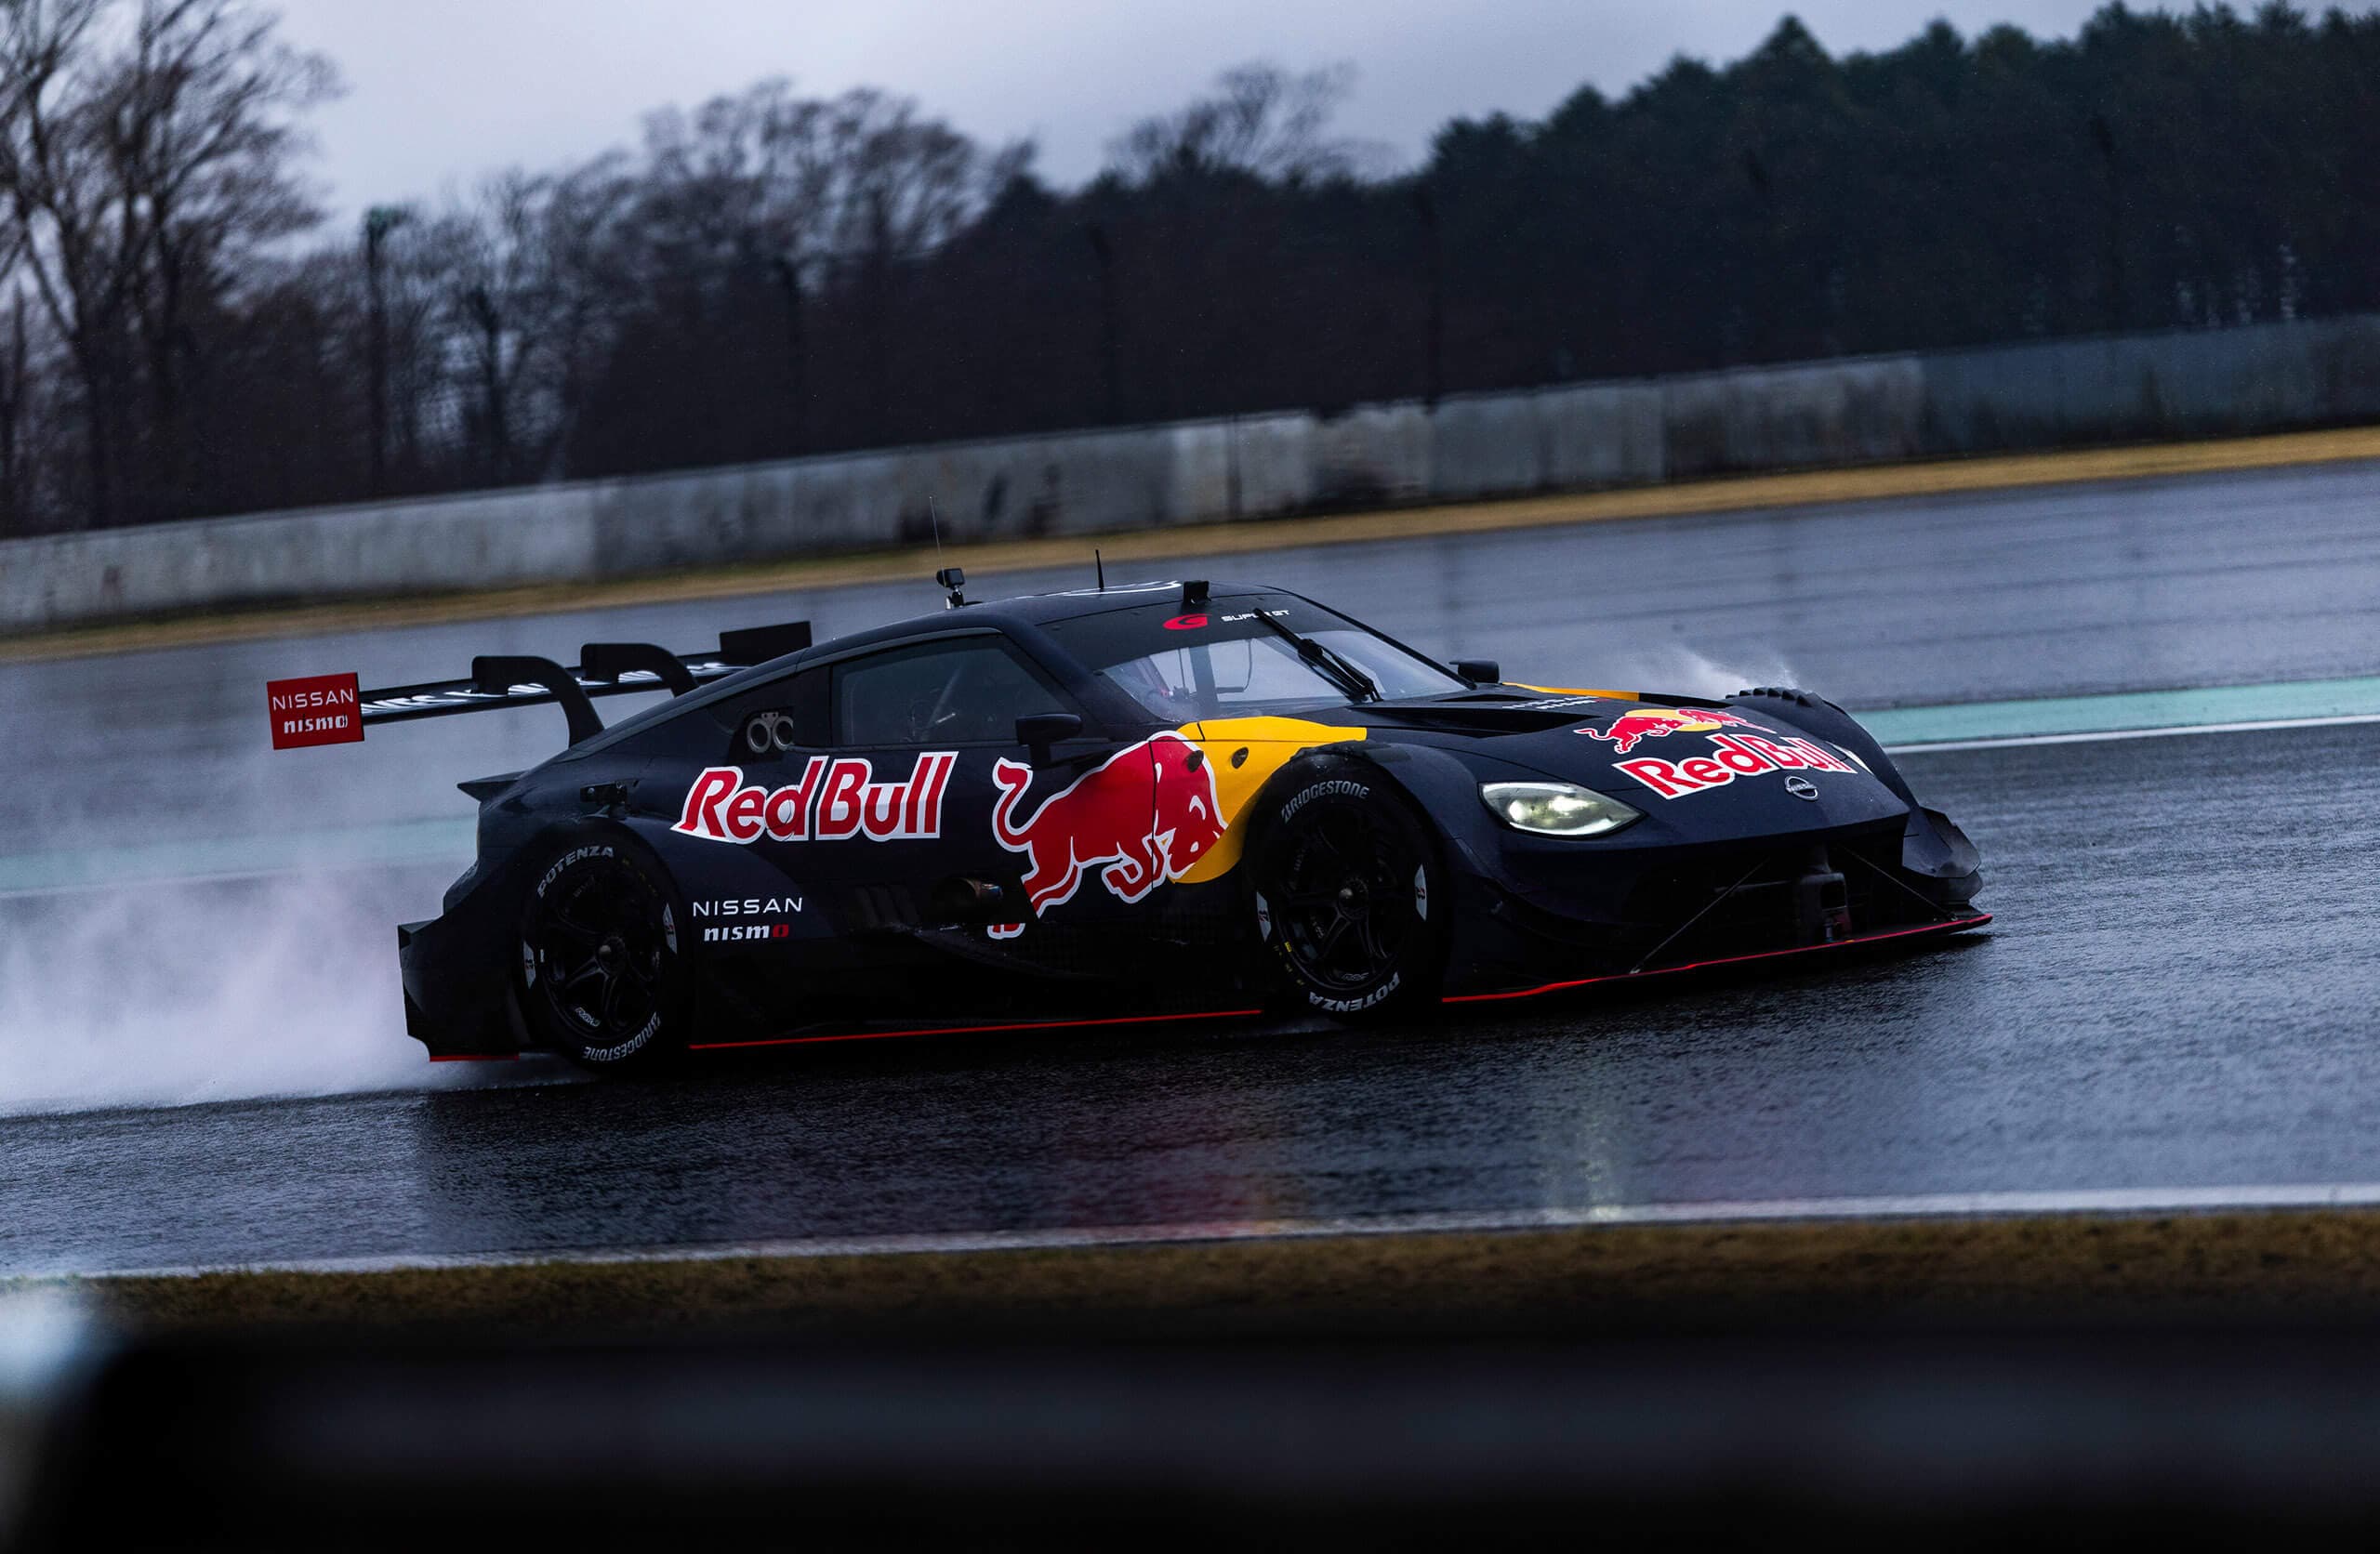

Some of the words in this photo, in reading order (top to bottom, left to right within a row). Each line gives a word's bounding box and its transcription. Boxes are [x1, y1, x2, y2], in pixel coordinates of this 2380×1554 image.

[272, 688, 354, 711] NISSAN
[284, 715, 349, 734] nismo
[1616, 734, 1777, 797] Red
[1731, 734, 1854, 773] Bull
[675, 757, 826, 840] Red
[816, 752, 956, 837] Bull
[1280, 779, 1370, 825] BRIDGESTONE
[536, 845, 615, 899] POTENZA
[693, 897, 802, 917] NISSAN
[704, 924, 789, 942] nismo
[1308, 970, 1401, 1012] POTENZA
[582, 1010, 662, 1062] BRIDGESTONE
